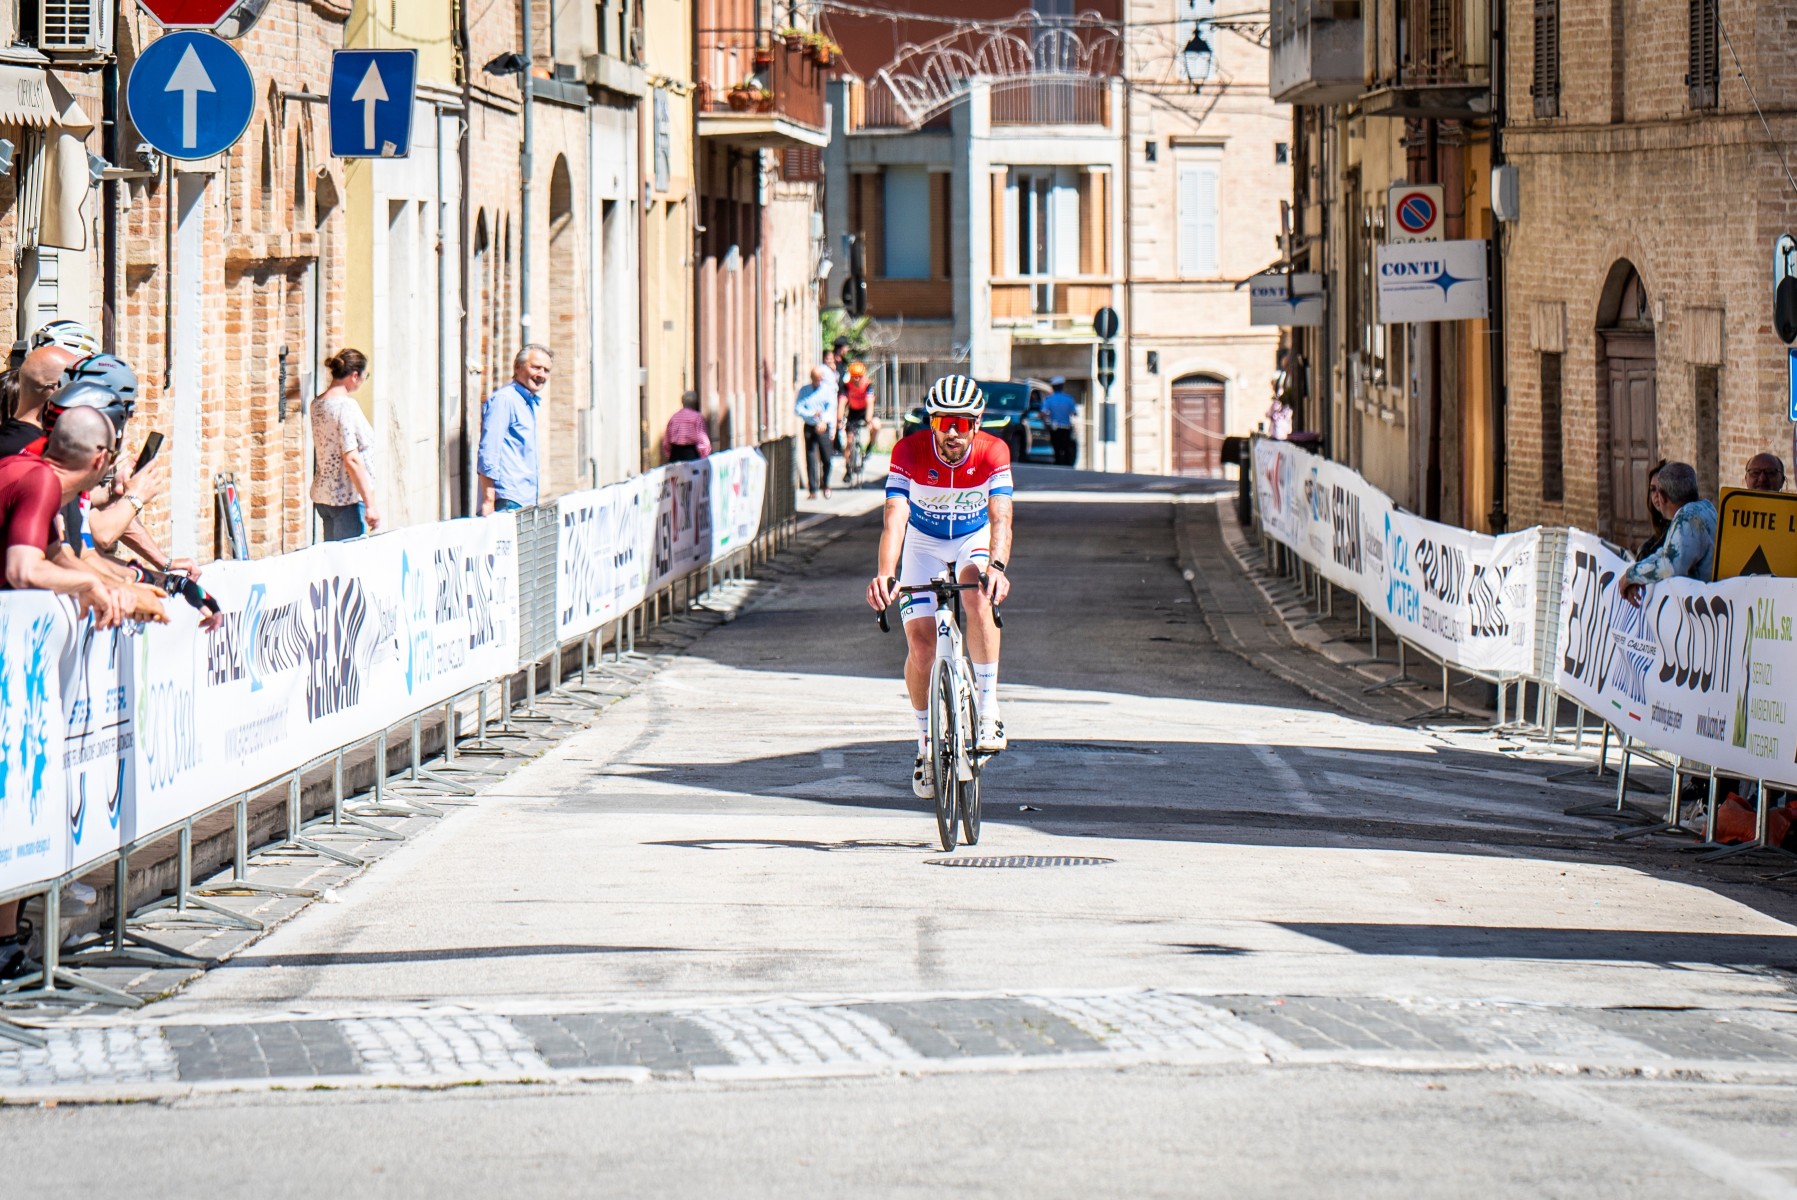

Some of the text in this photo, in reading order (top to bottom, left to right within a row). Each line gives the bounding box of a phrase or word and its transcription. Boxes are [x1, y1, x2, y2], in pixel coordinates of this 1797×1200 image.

[1382, 261, 1440, 276] CONTI
[1251, 287, 1288, 298] CONT
[1732, 508, 1776, 531] TUTTE
[1627, 638, 1657, 656] CALZATURE
[1752, 661, 1773, 686] SERVIZI
[1750, 697, 1787, 725] AMBIENTALI
[1748, 731, 1779, 760] INTEGRATI
